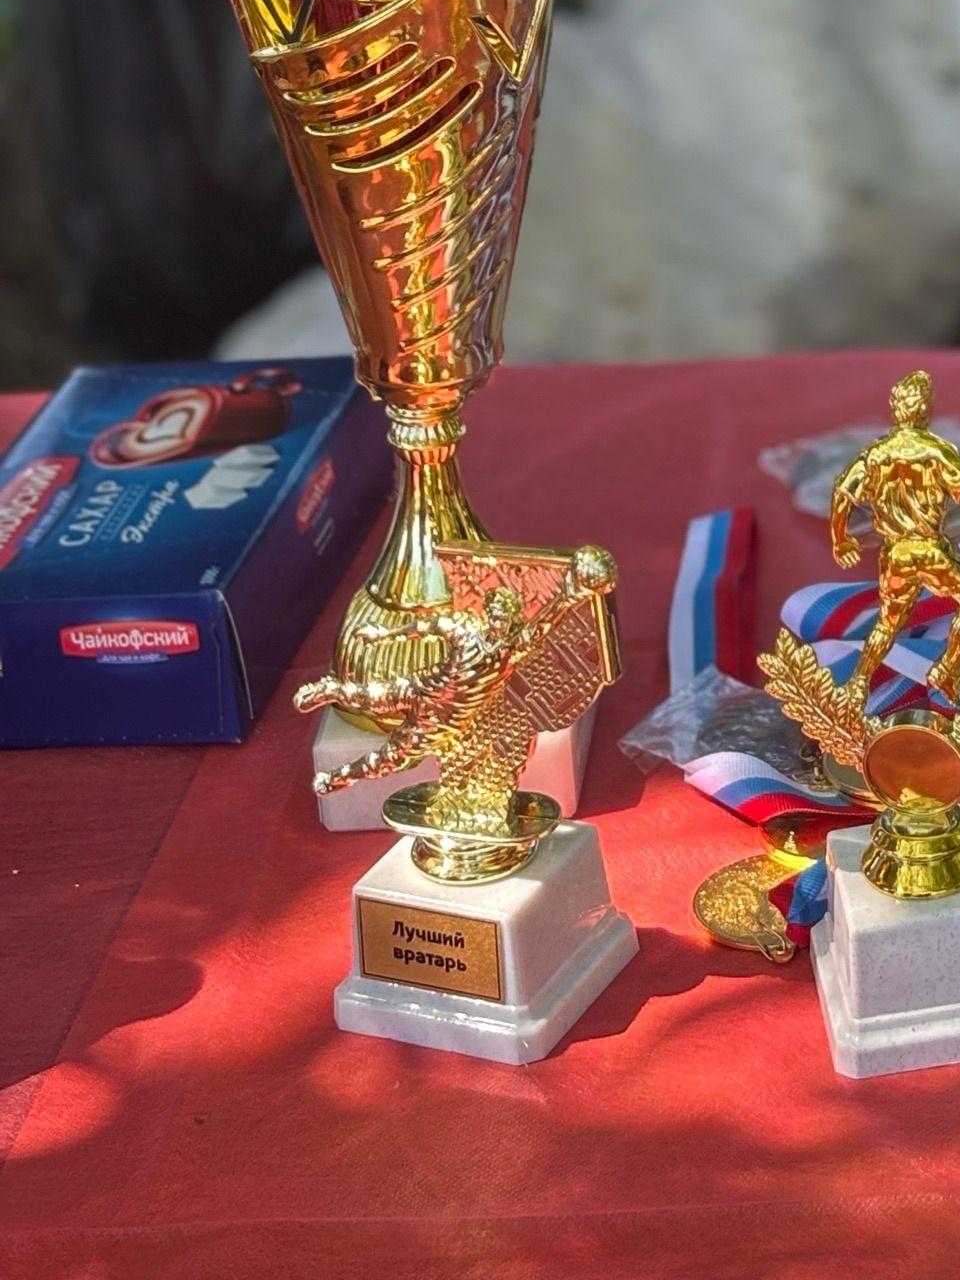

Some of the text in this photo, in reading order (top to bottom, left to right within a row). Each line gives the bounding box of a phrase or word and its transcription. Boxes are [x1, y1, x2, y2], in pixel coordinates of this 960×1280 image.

[59, 480, 123, 546] САХАР
[120, 478, 180, 544] Экстра
[70, 625, 190, 650] Чайкофский
[392, 920, 465, 949] Лучший
[393, 946, 468, 973] вратарь
